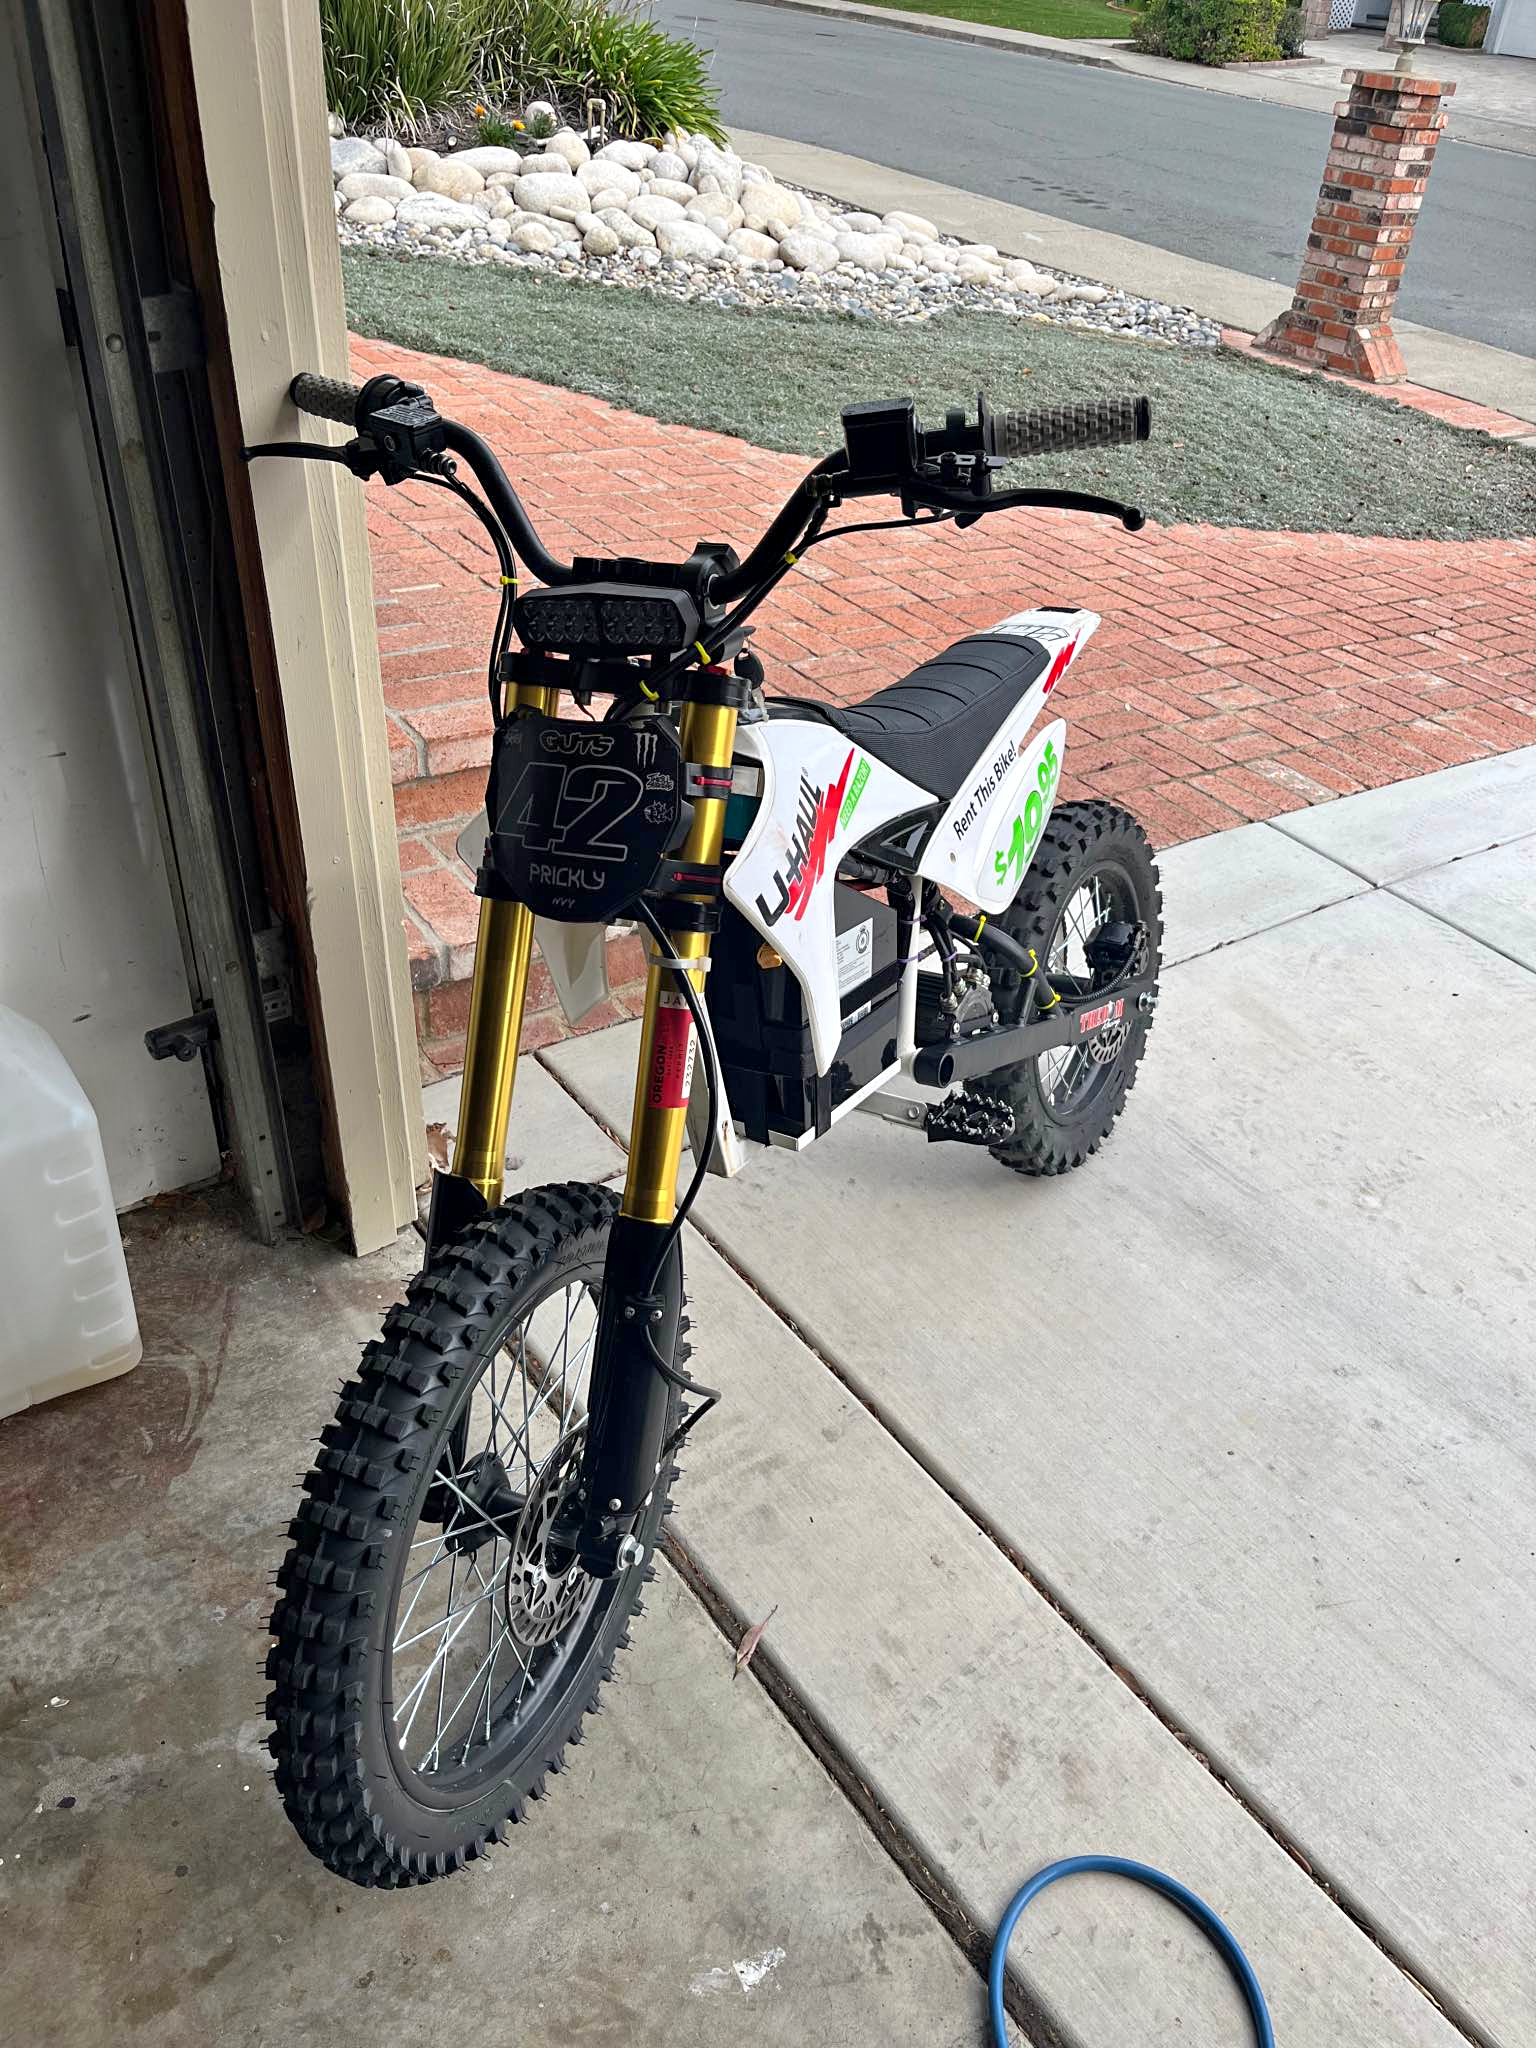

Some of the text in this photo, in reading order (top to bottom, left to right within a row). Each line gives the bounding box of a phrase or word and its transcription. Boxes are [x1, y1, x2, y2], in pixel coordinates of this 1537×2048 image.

[539, 729, 615, 757] GUTS
[494, 761, 644, 862] 42
[953, 740, 1017, 841] Rent This Bike!
[529, 863, 606, 890] PRICKLY
[755, 774, 822, 927] U-HAUL
[652, 1041, 668, 1104] OREGON
